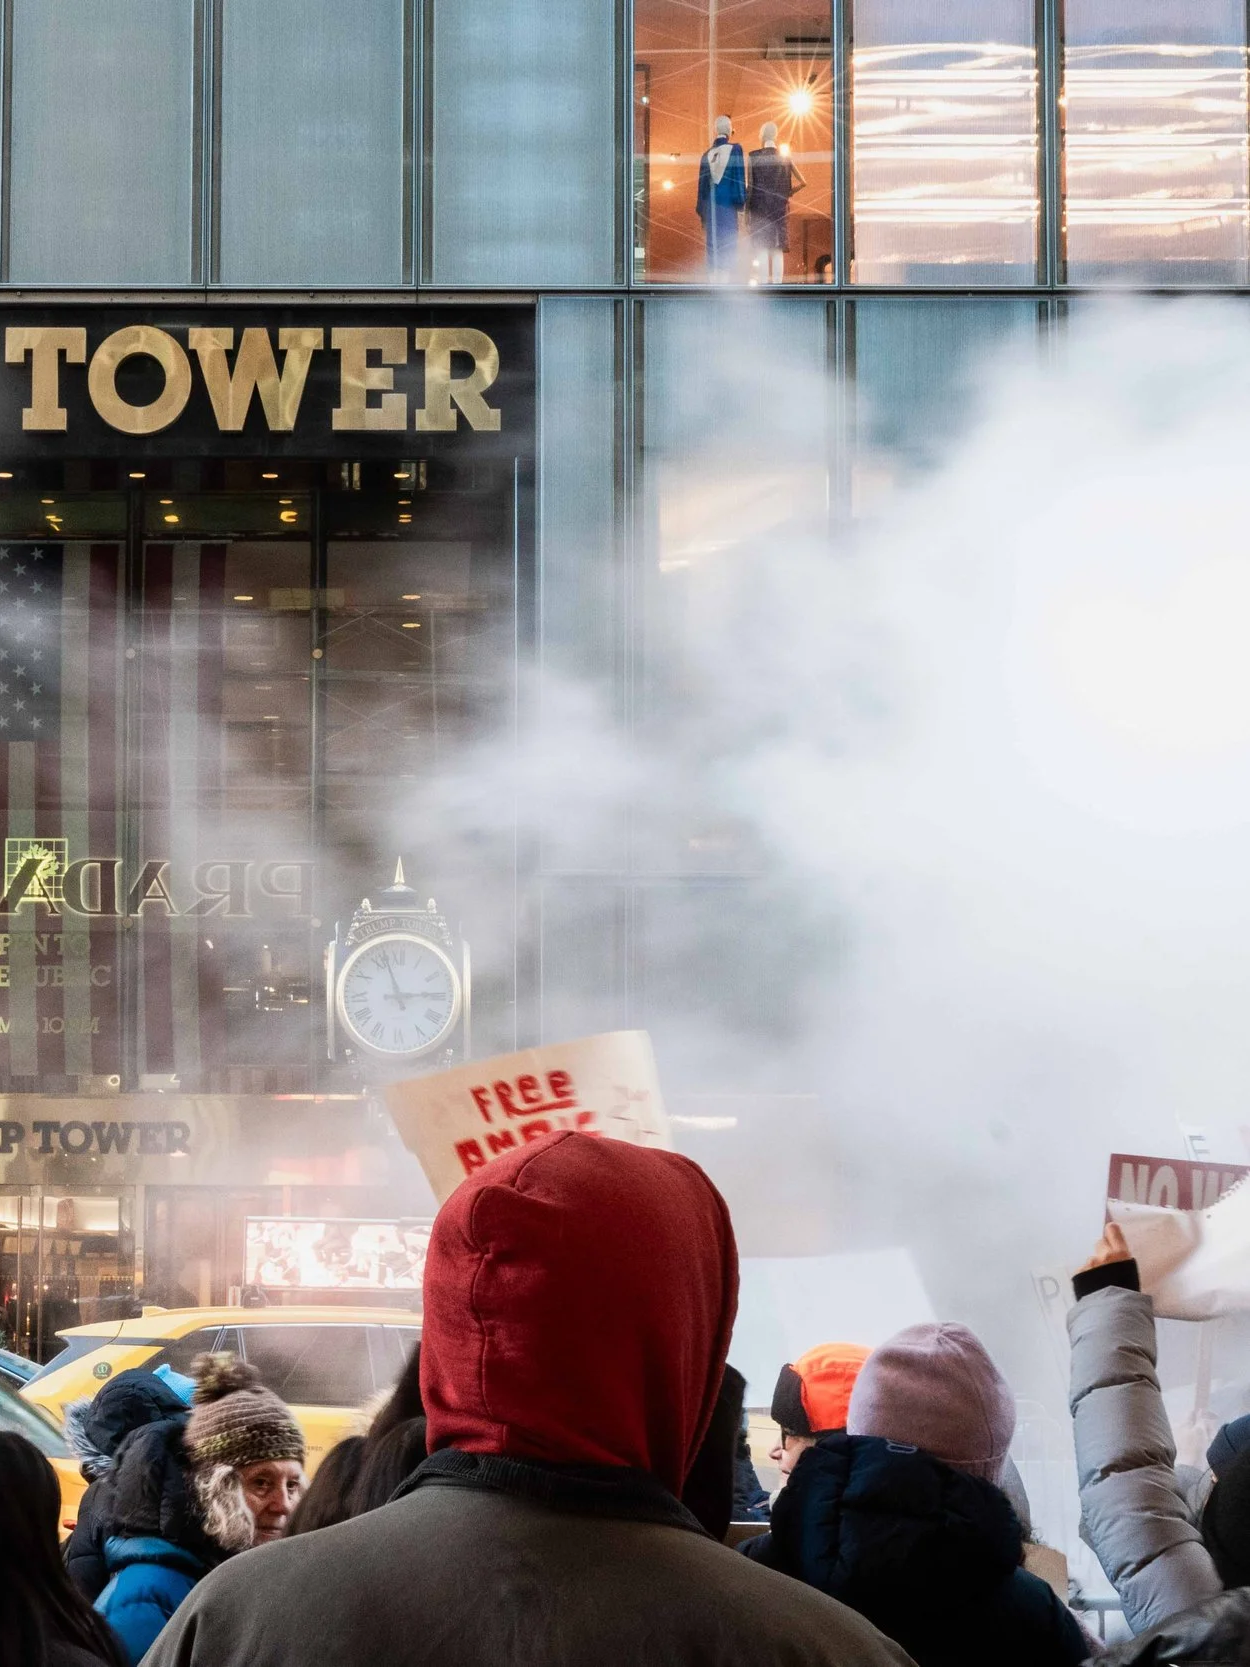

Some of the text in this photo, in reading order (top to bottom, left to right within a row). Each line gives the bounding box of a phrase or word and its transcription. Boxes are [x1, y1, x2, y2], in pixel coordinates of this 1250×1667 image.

[4, 324, 503, 435] TOWER
[357, 919, 396, 938] TRUMP
[469, 1070, 579, 1124] FREE
[33, 1120, 191, 1155] TOWER
